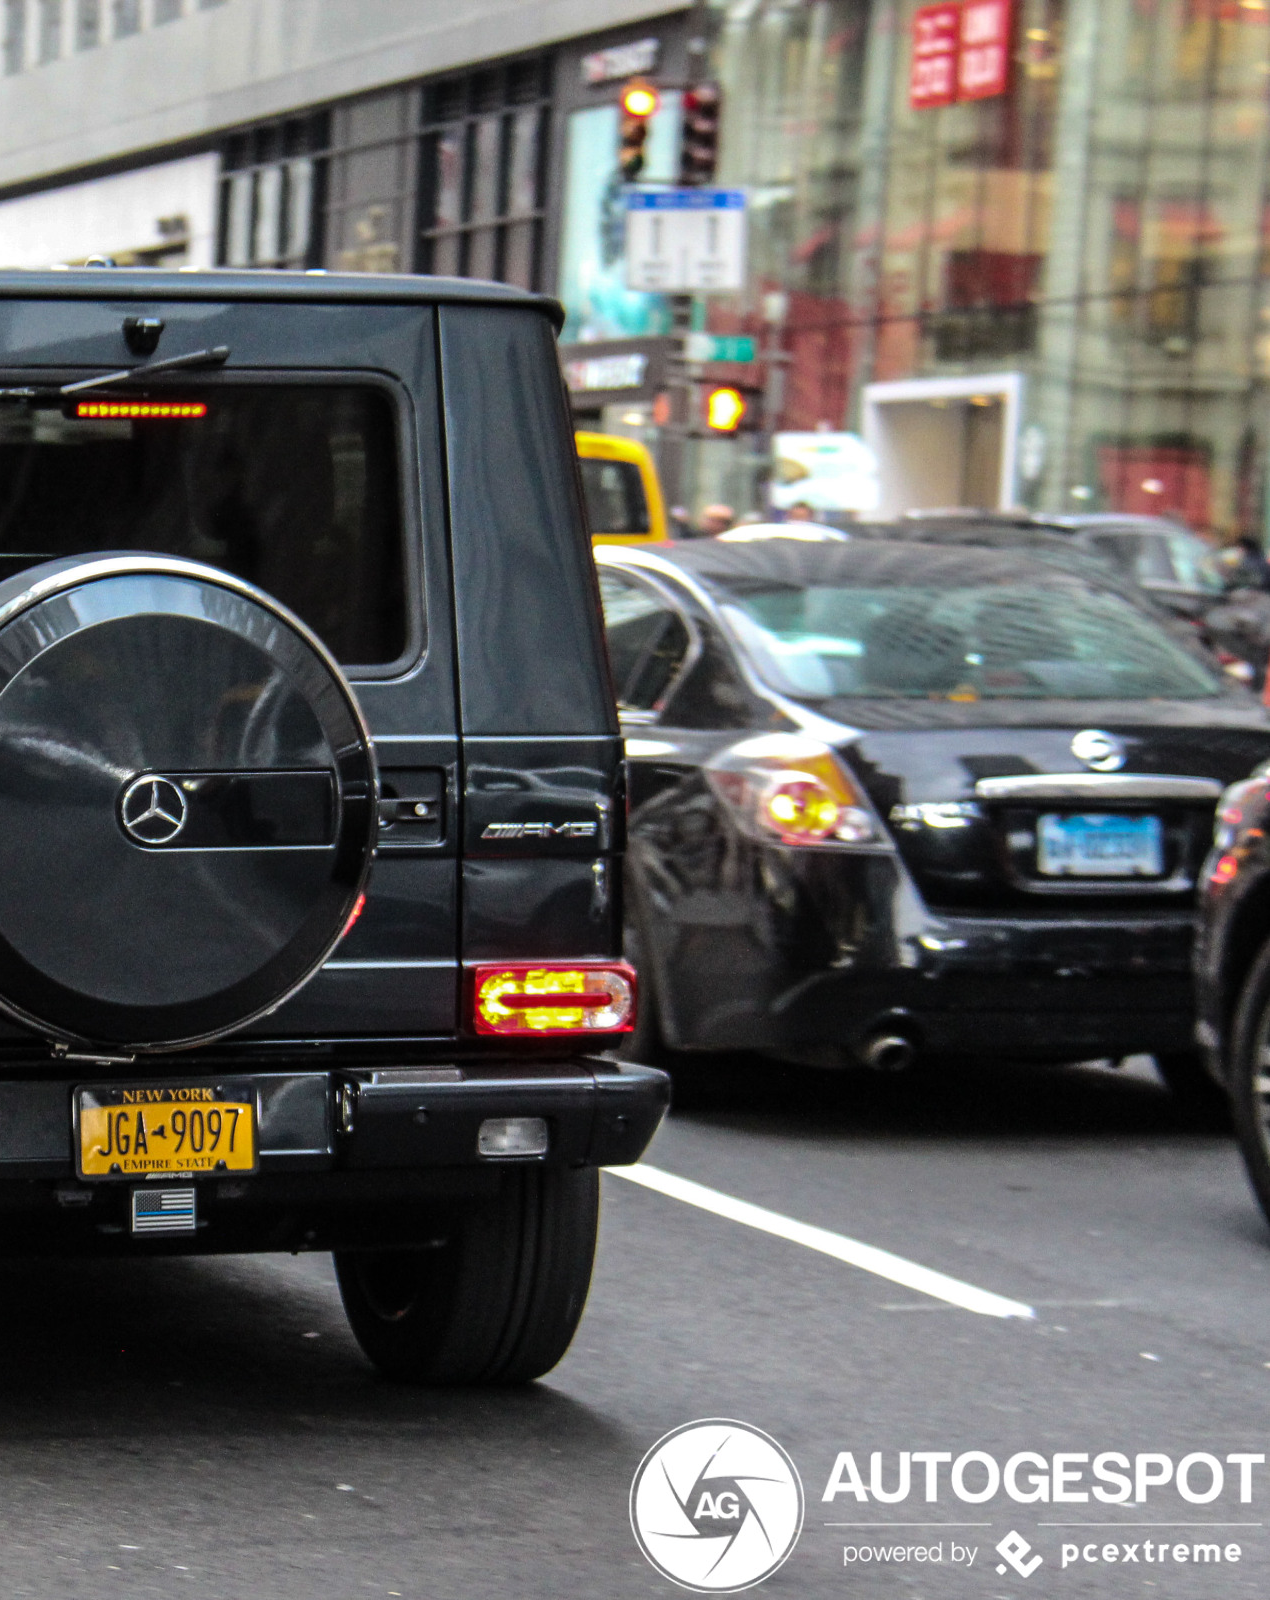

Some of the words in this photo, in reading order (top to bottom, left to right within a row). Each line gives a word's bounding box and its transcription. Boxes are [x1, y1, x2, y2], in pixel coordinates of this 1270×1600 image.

[122, 1089, 163, 1103] NEW
[168, 1088, 213, 1101] YORK
[97, 1110, 148, 1156] JGA
[171, 1108, 242, 1153] 9097
[123, 1159, 172, 1170] EMPIRE
[176, 1157, 214, 1167] STATE
